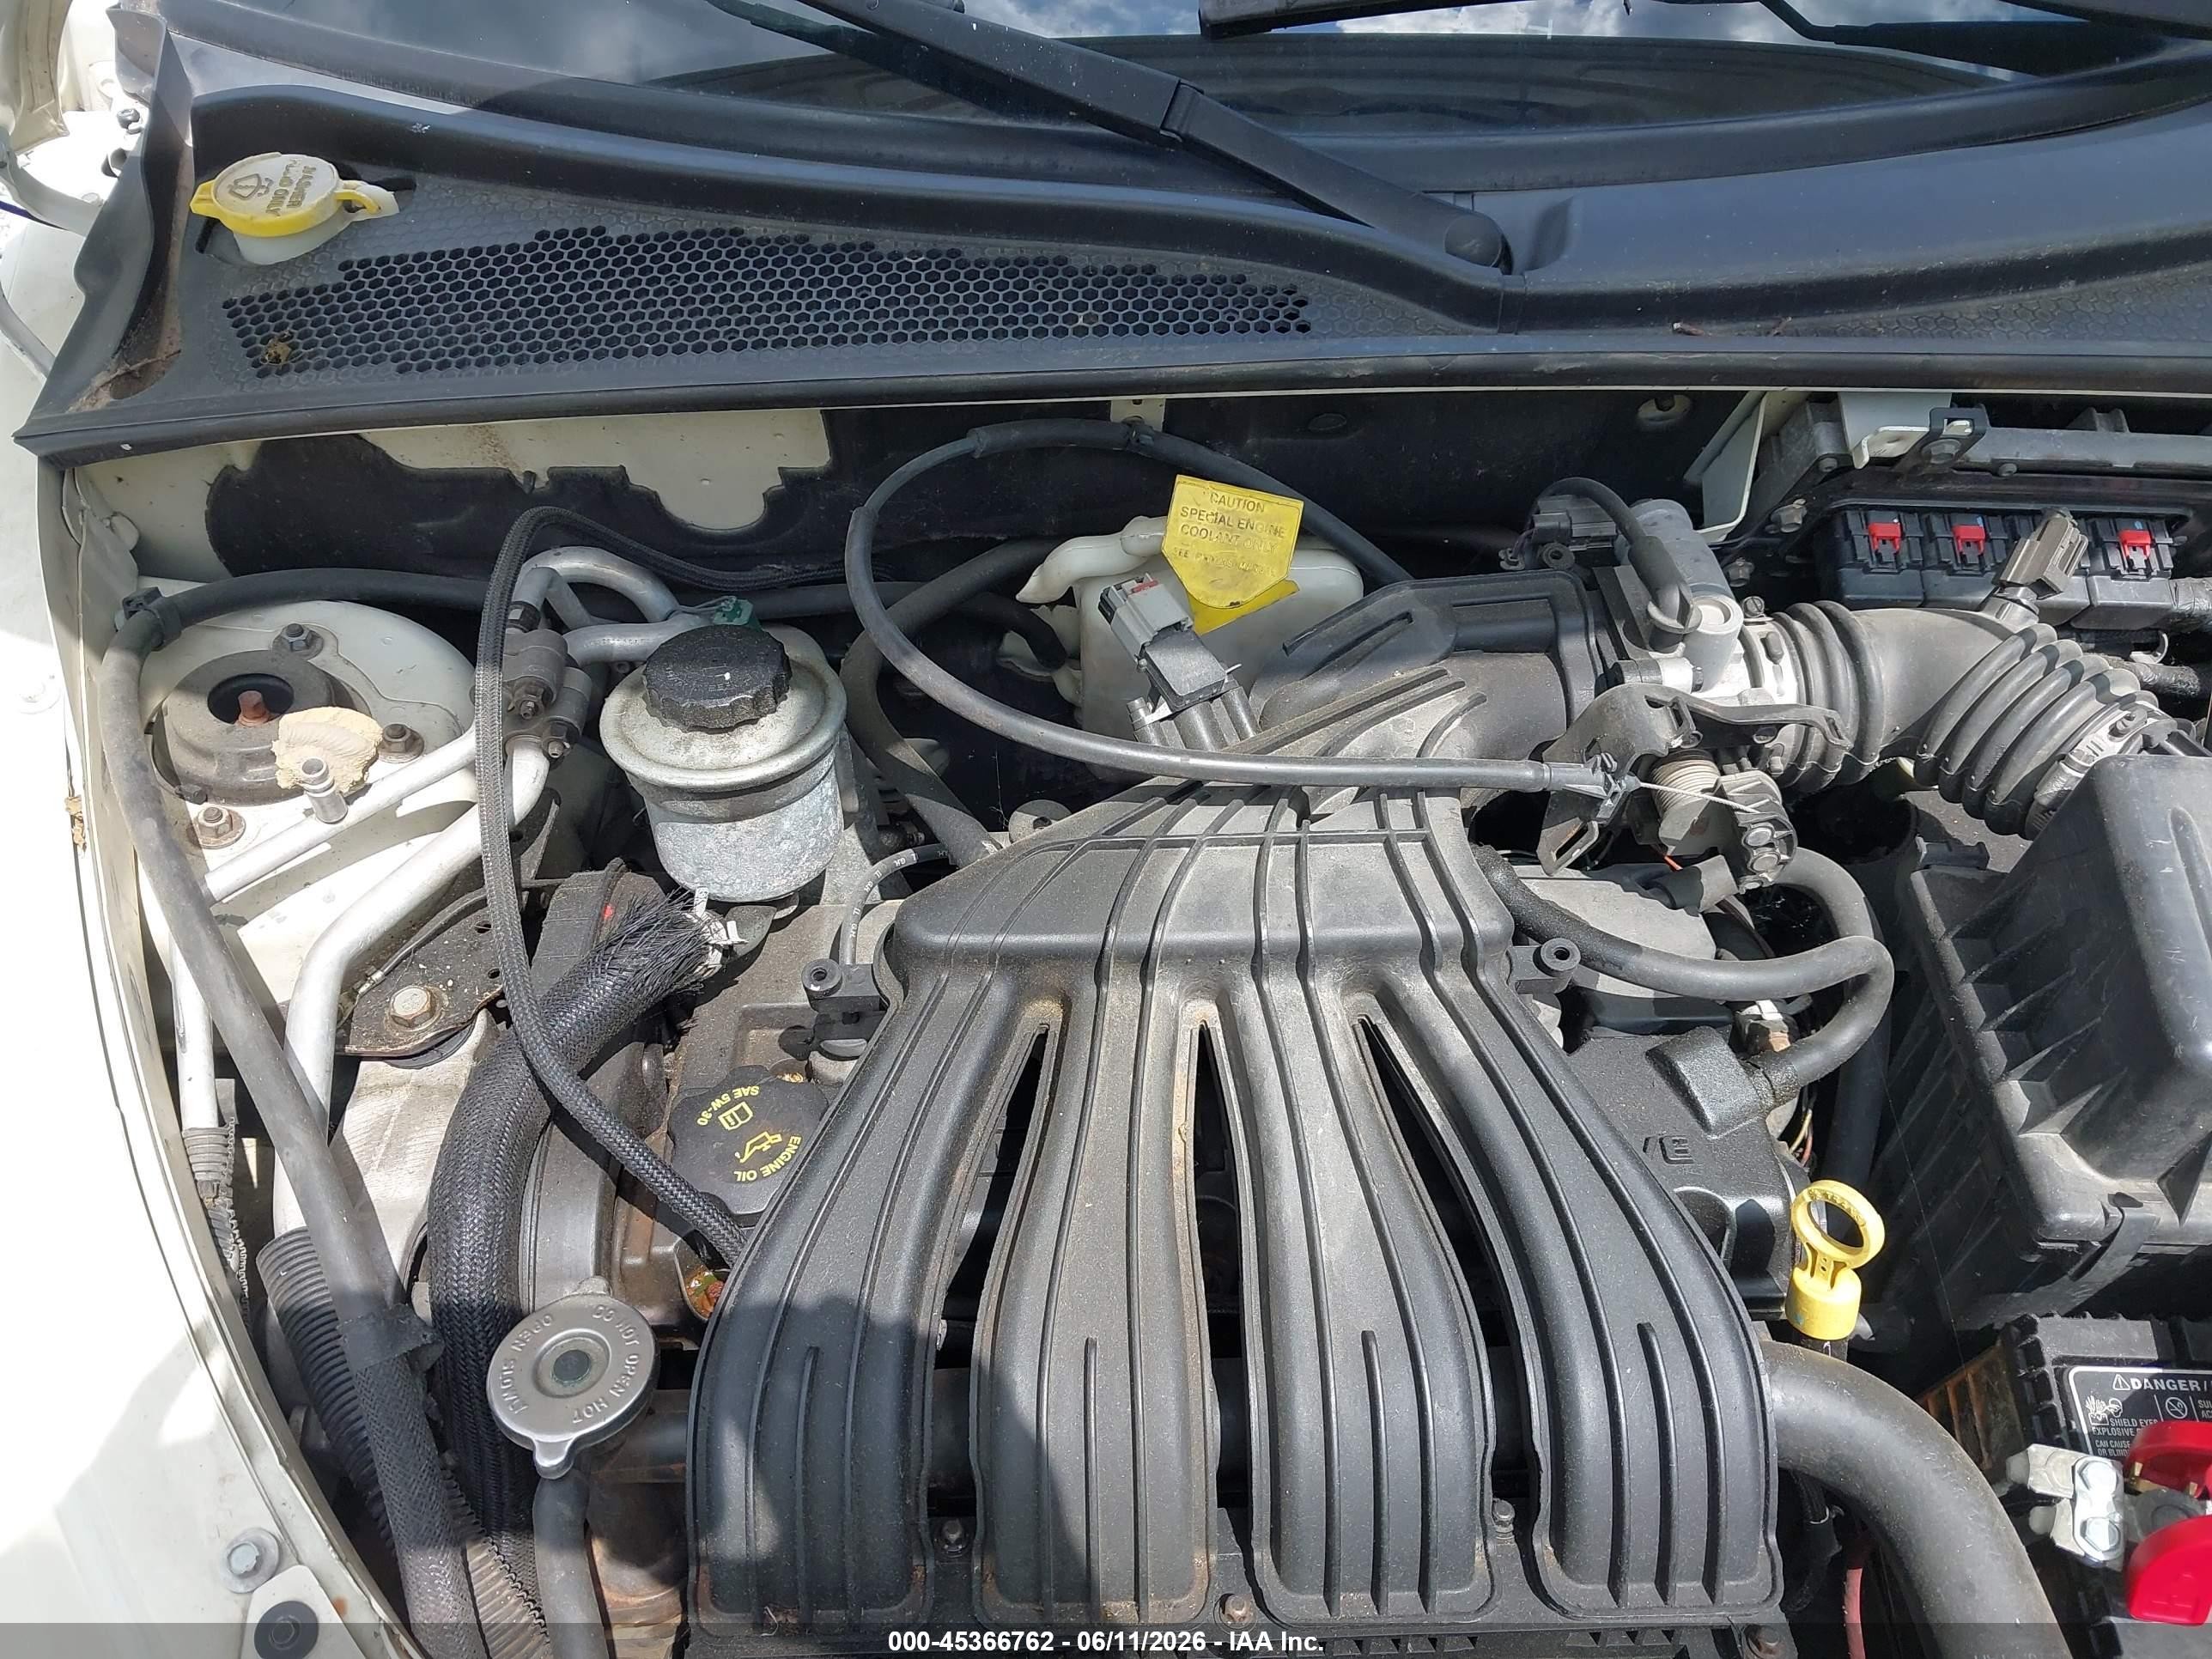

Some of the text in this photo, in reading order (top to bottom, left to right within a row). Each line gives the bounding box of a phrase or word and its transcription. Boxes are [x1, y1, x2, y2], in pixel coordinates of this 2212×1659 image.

[265, 187, 289, 217] ONLY
[1209, 491, 1266, 514] CAUTION
[1180, 506, 1286, 539] SPECIAL ENGINE
[1180, 524, 1279, 555] COOLANT ONLY
[696, 1085, 760, 1126] SAE 5W-30
[733, 1134, 803, 1182] ENGINE OIL
[510, 1312, 555, 1352] OPEN
[614, 1320, 641, 1347] NOT
[608, 1352, 641, 1398] OPEN
[2130, 1377, 2202, 1392] DANGER
[571, 1396, 611, 1424] HOT
[2110, 1418, 2138, 1427] SHIELD
[2091, 1426, 2136, 1437] EXPLOSIVE
[2095, 1440, 2109, 1449] CAN
